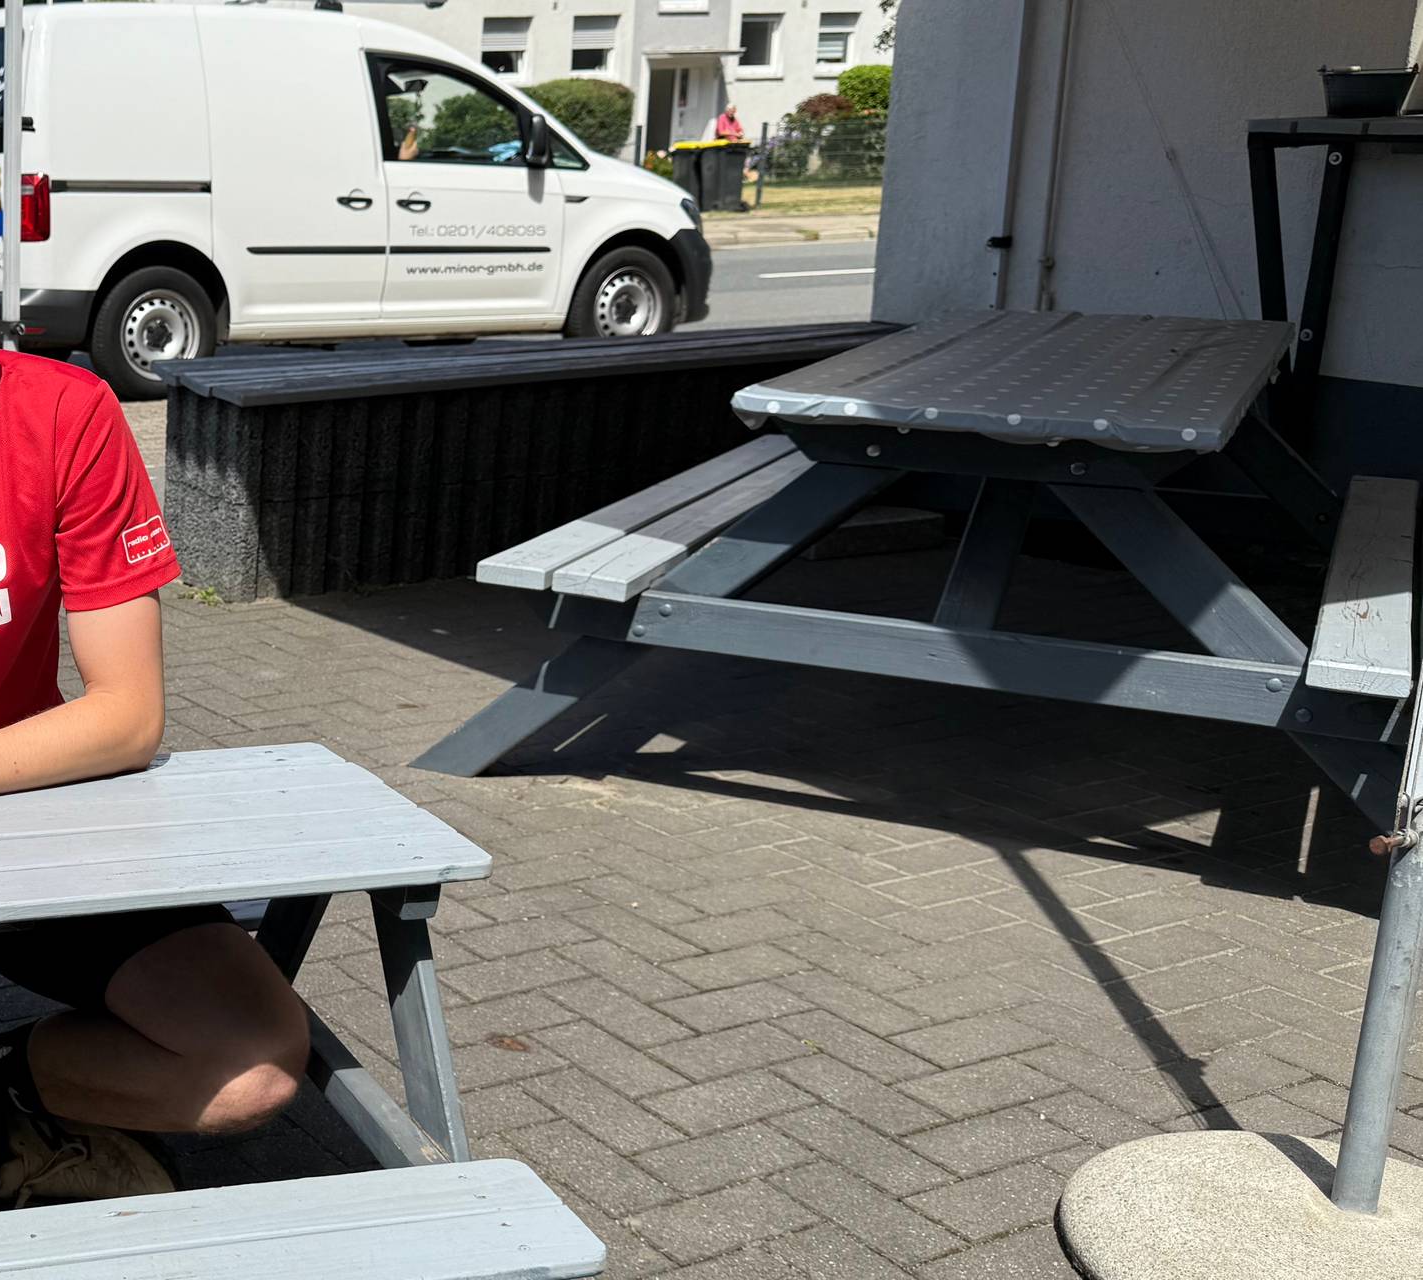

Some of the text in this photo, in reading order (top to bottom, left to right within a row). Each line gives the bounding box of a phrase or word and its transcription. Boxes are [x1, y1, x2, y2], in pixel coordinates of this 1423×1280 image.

[437, 224, 546, 239] 0201/408095
[406, 262, 544, 275] www.minor-gmbh.de
[127, 535, 148, 548] radio
